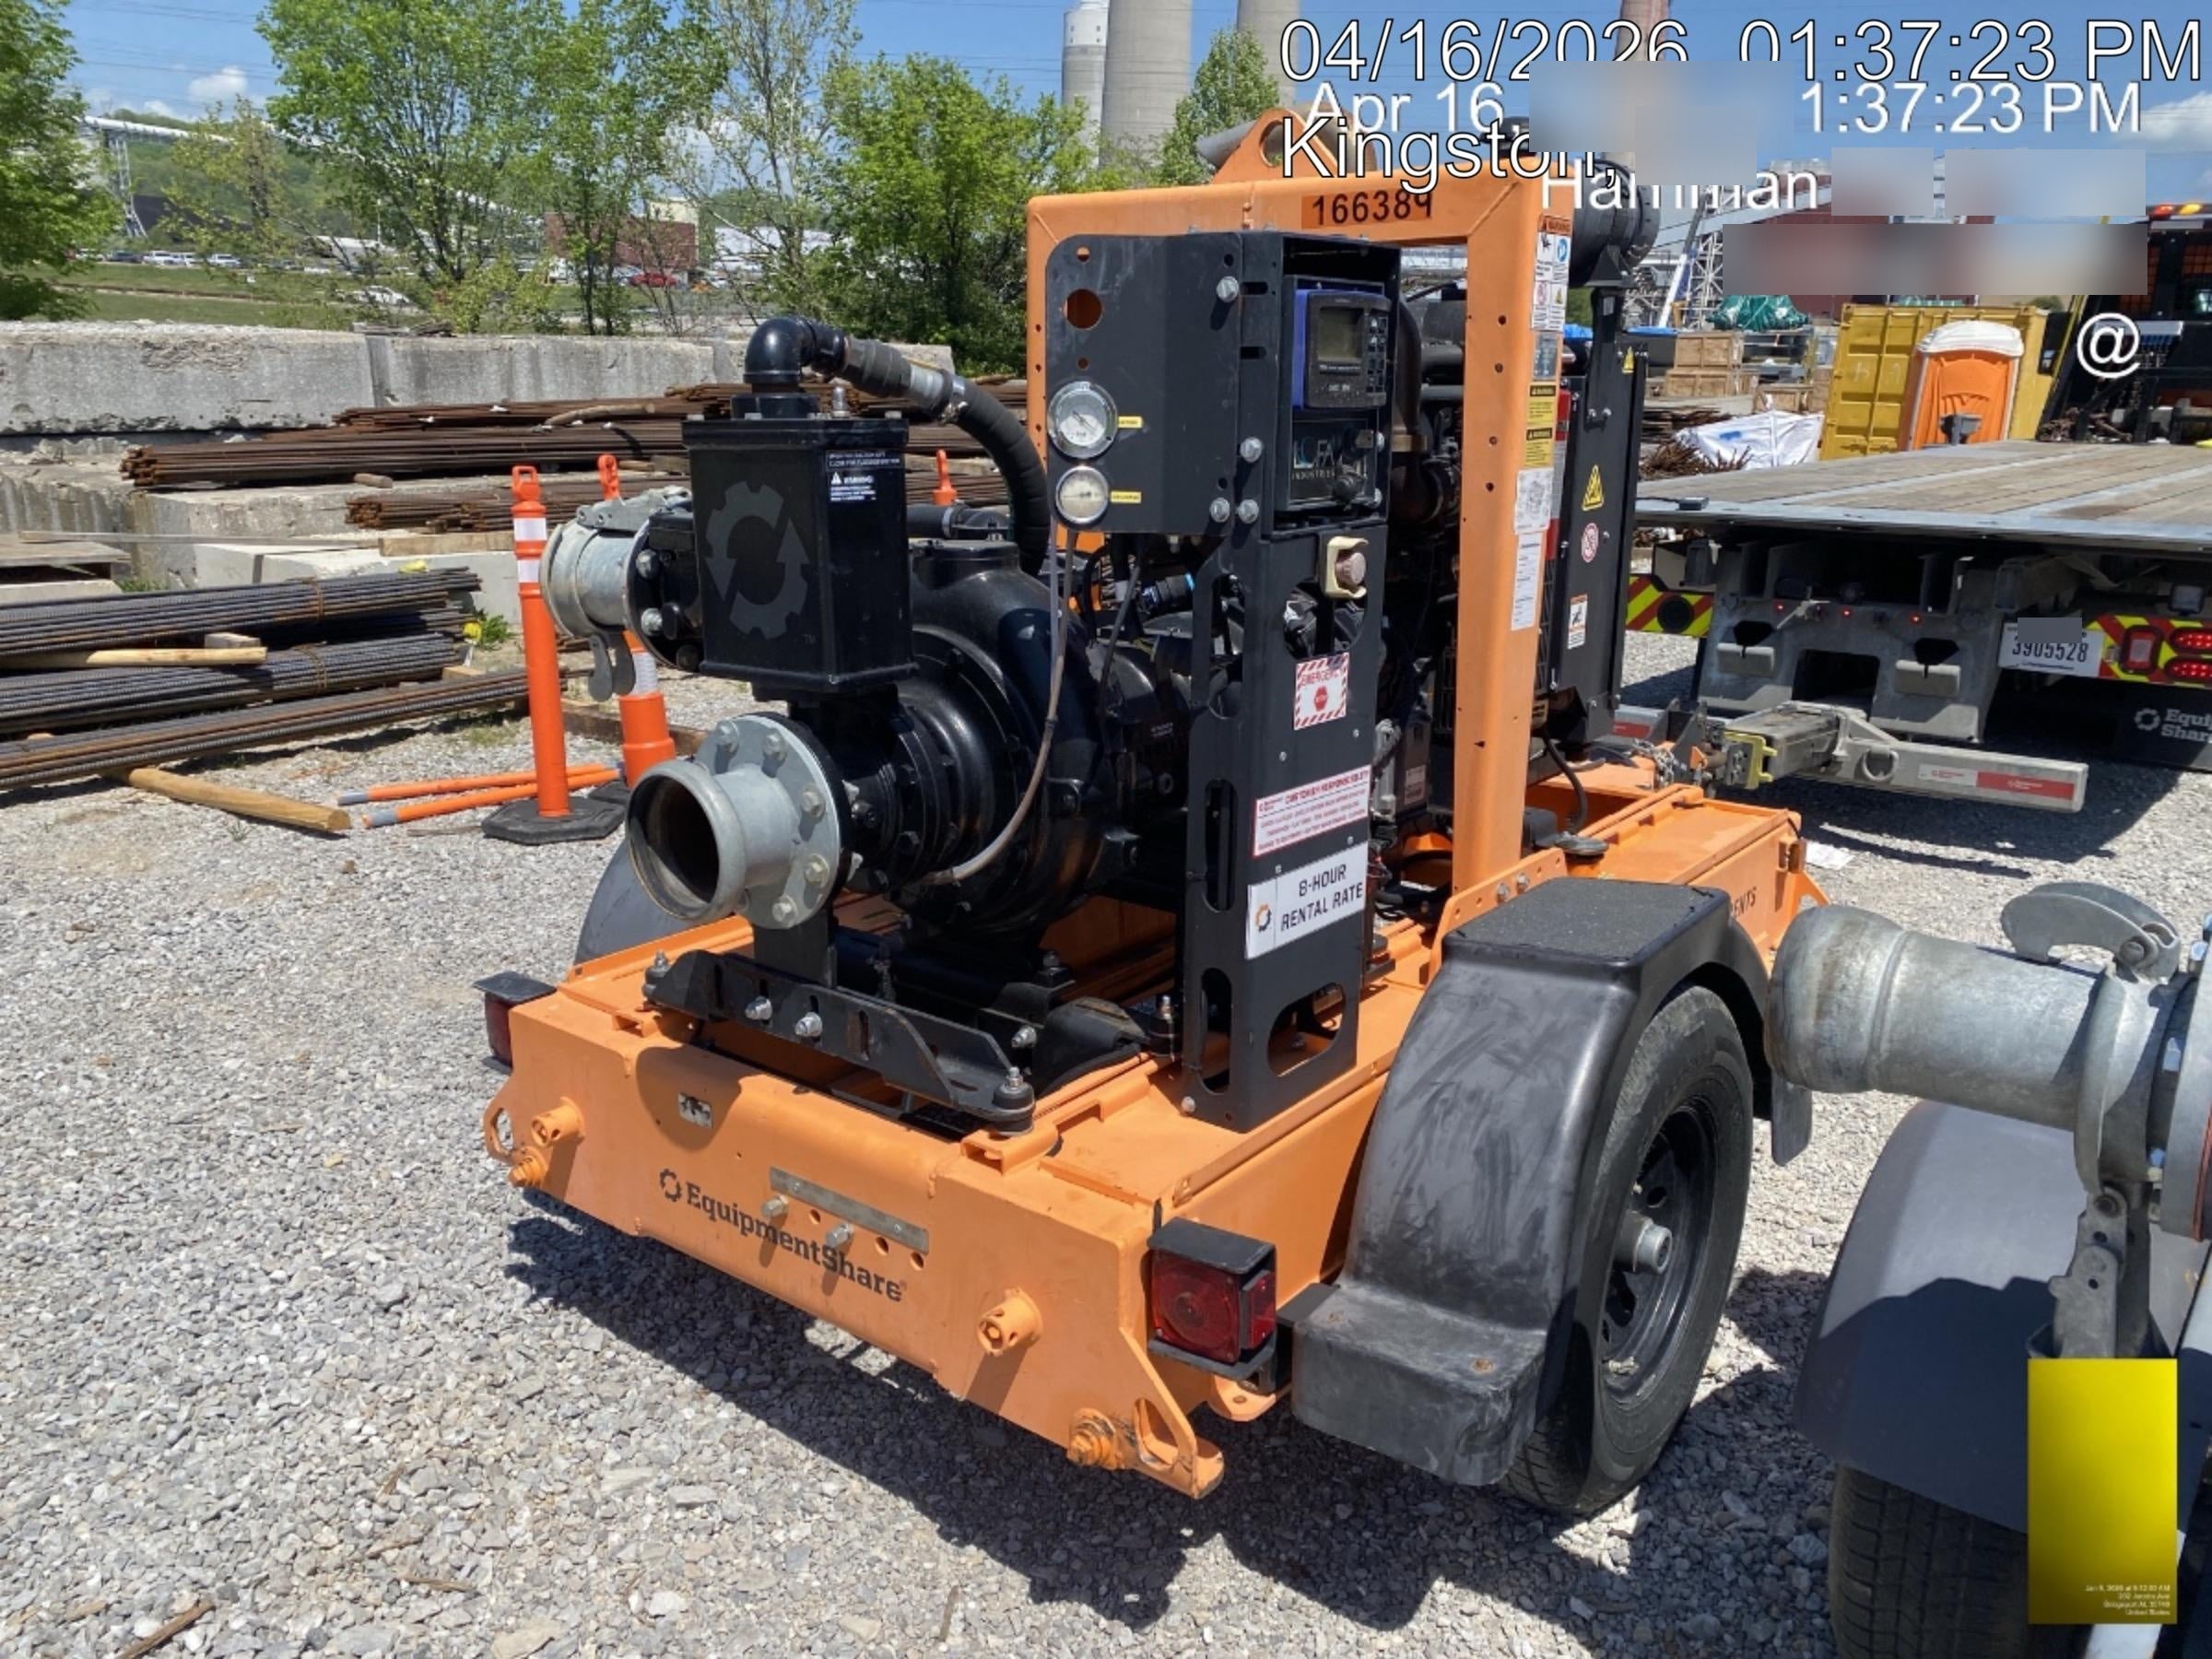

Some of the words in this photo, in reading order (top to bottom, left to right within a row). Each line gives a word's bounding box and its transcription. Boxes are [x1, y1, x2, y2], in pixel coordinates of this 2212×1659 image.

[1299, 864, 1347, 897] 8-HOUR
[1280, 897, 1328, 932] RENTAL
[1332, 882, 1363, 910] RATE
[686, 1181, 903, 1302] EquipmentShare
